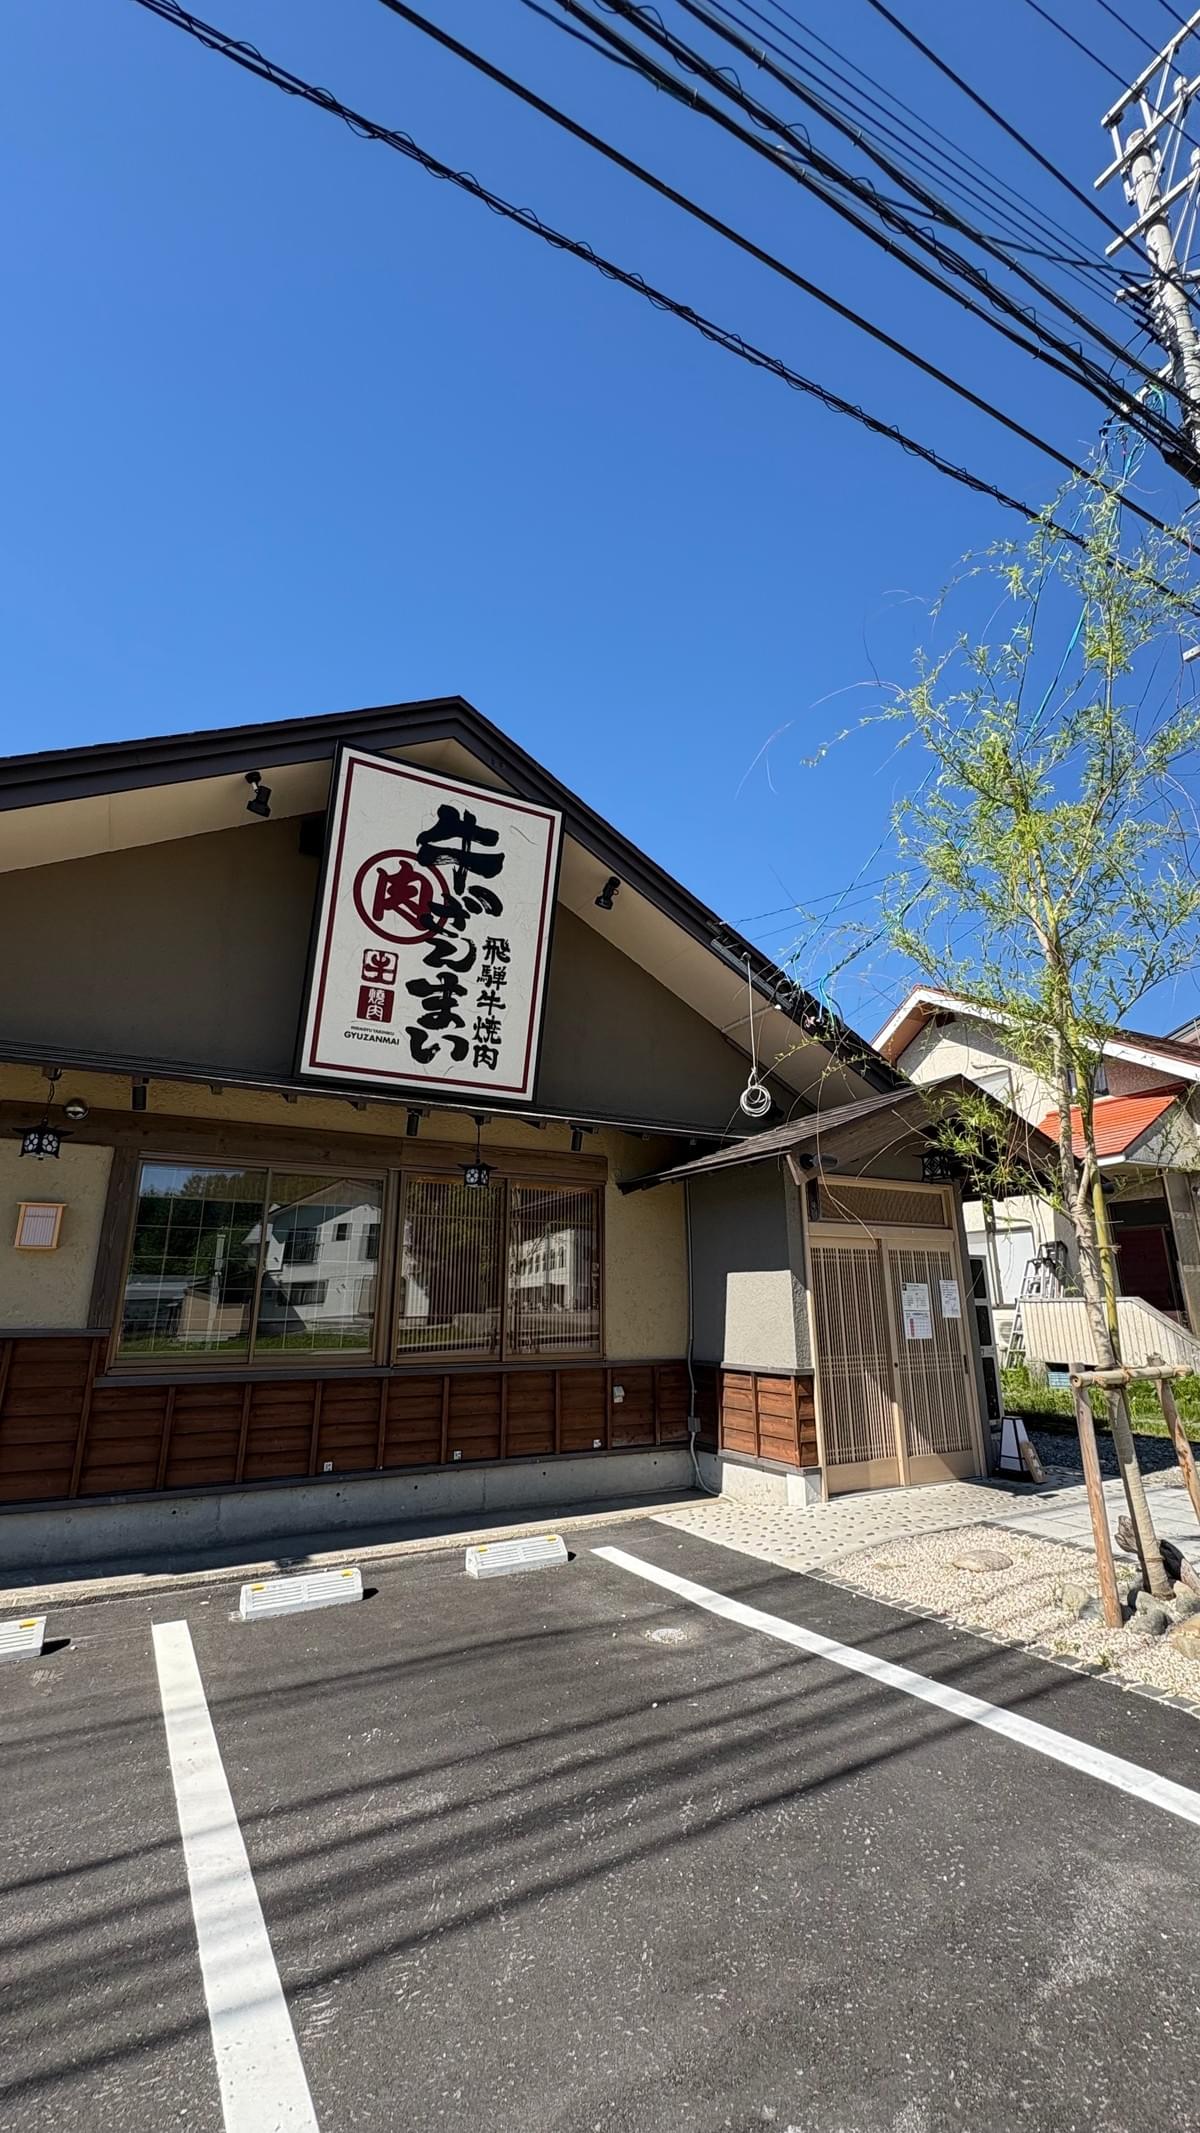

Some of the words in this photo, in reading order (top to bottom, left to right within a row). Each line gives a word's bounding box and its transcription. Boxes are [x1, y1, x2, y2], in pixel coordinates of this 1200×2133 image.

[372, 859, 434, 931] 肉
[343, 1030, 400, 1046] GYUZANMAI
[472, 936, 511, 1070] 飛騨牛焼肉
